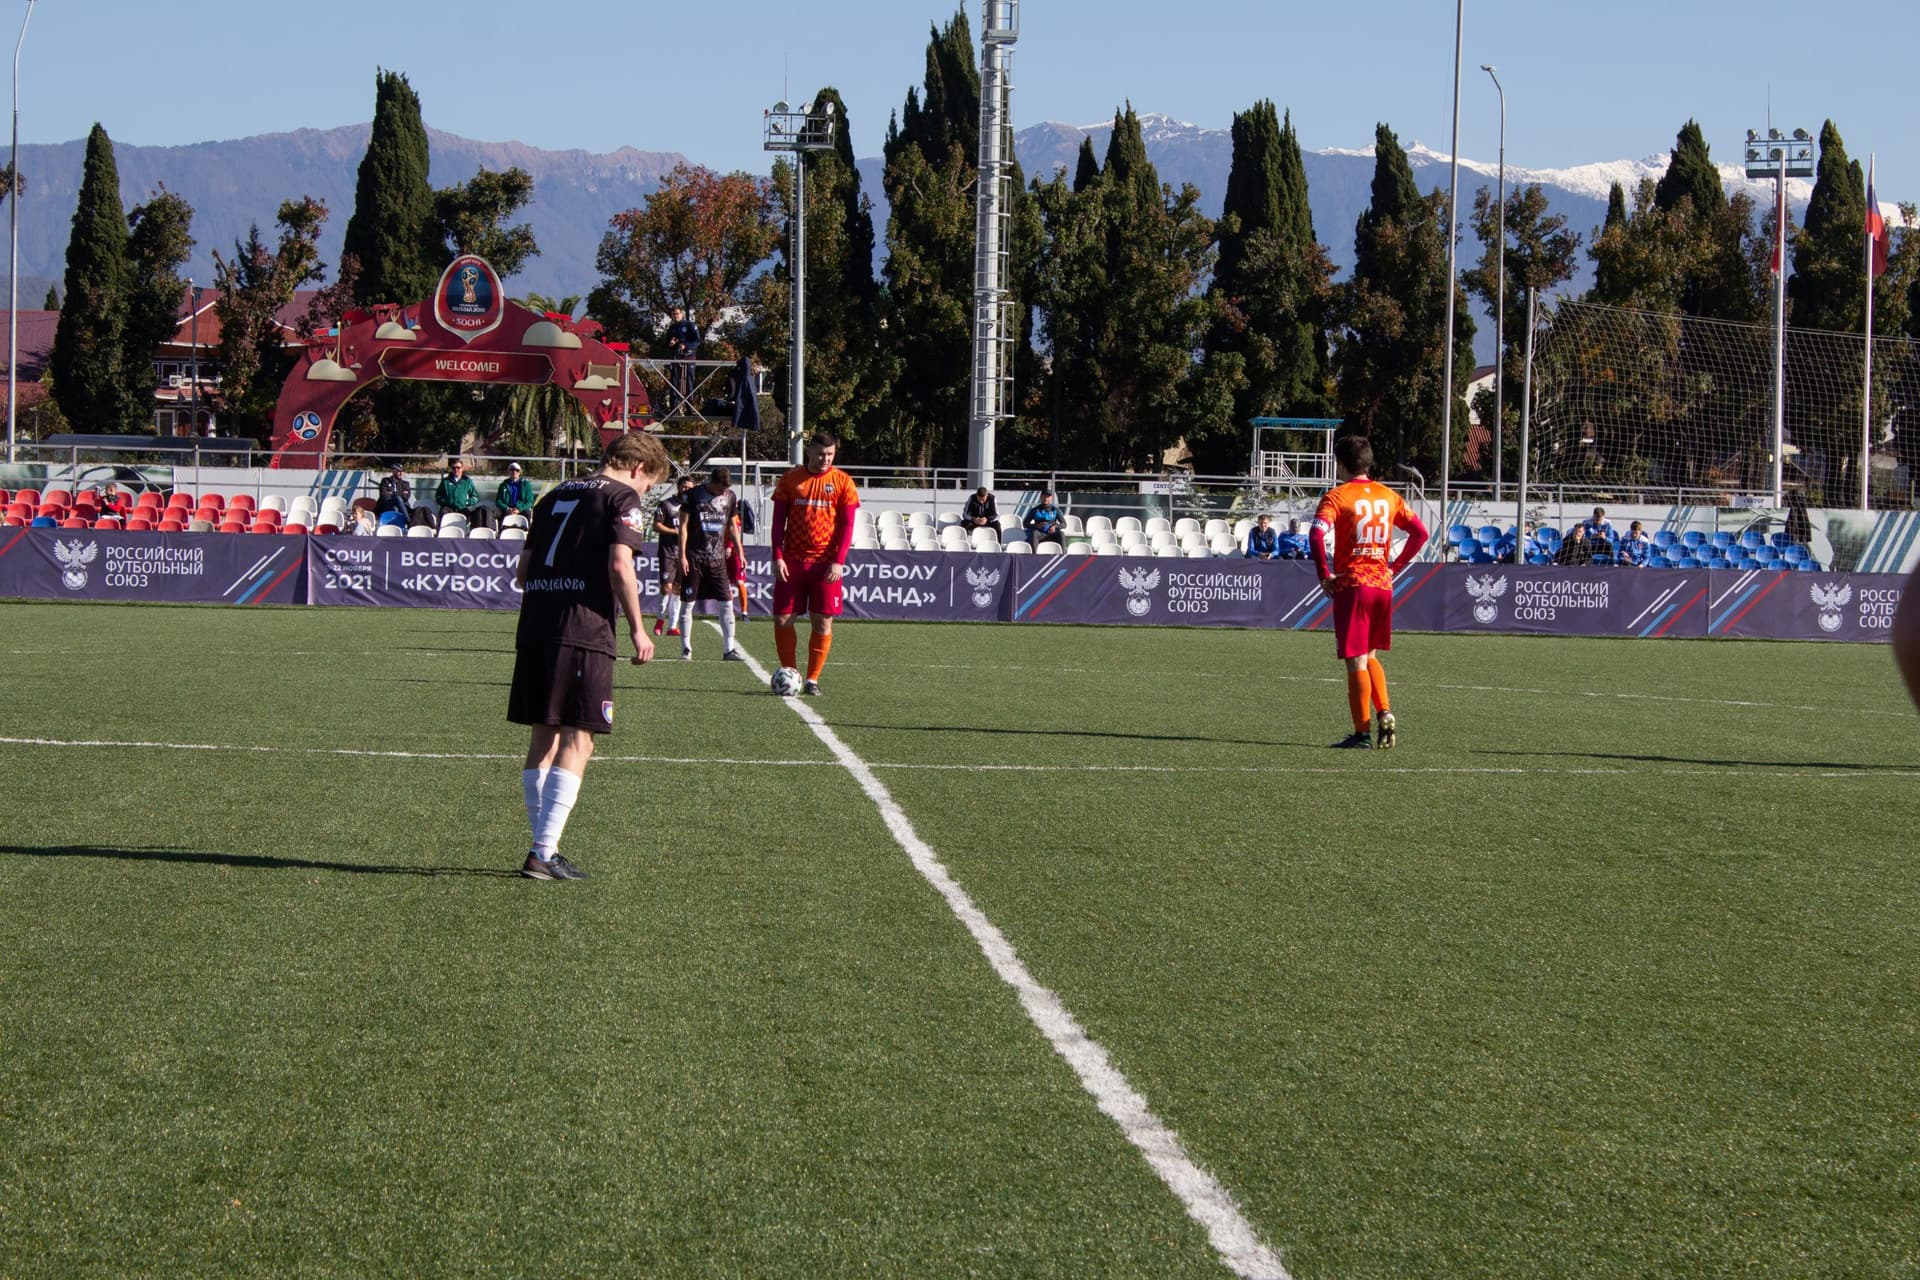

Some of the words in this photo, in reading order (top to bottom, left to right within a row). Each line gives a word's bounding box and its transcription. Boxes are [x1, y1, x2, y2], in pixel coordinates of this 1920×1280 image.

[435, 359, 499, 373] WELCOME!
[1354, 499, 1390, 544] 23
[544, 500, 580, 568] 7
[105, 546, 204, 561] РОССИЙСКИЙ
[325, 549, 373, 563] СОЧИ
[401, 551, 521, 569] ВСЕРОССИ
[105, 559, 204, 575] ФУТБОЛЬНЫЙ
[105, 574, 148, 587] СОЮЗ
[325, 574, 373, 590] 2021
[401, 574, 503, 593] «КУБОК
[1168, 572, 1262, 588] РОССИЙСКИЙ
[1168, 586, 1262, 601] ФУТБОЛЬНЫЙ
[1515, 580, 1609, 596] РОССИЙСКИЙ
[1167, 600, 1209, 613] СОЮЗ
[1514, 593, 1609, 608] ФУТБОЛЬНЫЙ
[1514, 607, 1556, 620] СОЮЗ
[1859, 615, 1892, 628] СОЮ
